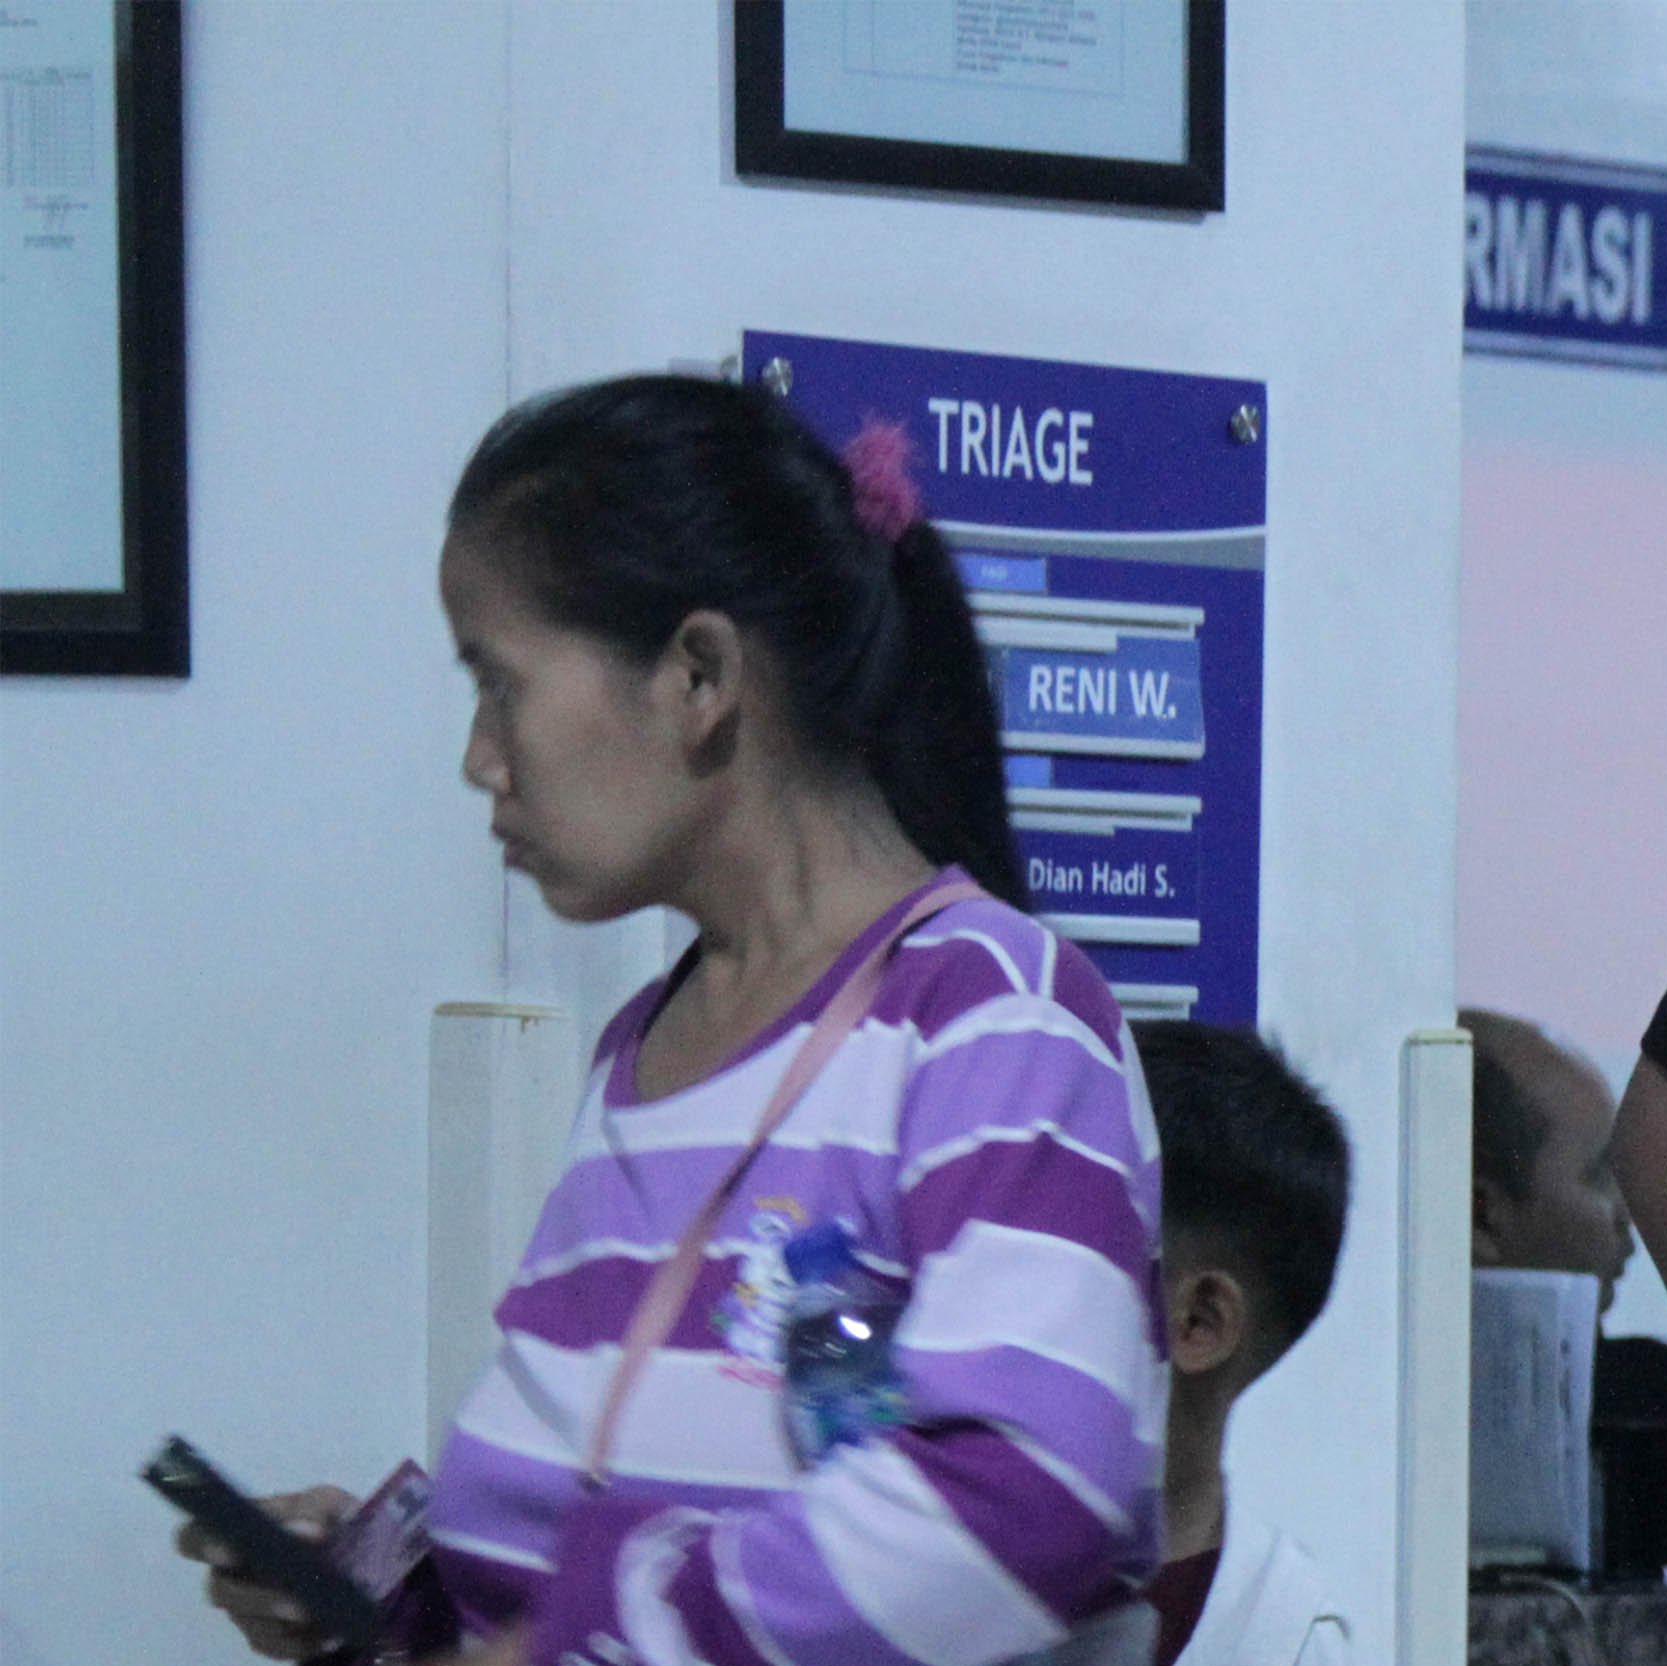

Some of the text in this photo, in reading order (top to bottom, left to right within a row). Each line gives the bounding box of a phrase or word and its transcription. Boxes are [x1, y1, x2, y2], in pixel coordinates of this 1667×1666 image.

[1465, 192, 1653, 325] RMASI
[929, 398, 1094, 487] TRIAGE
[1029, 664, 1177, 720] RENI W.
[1028, 856, 1176, 898] Dian Hadi S.
